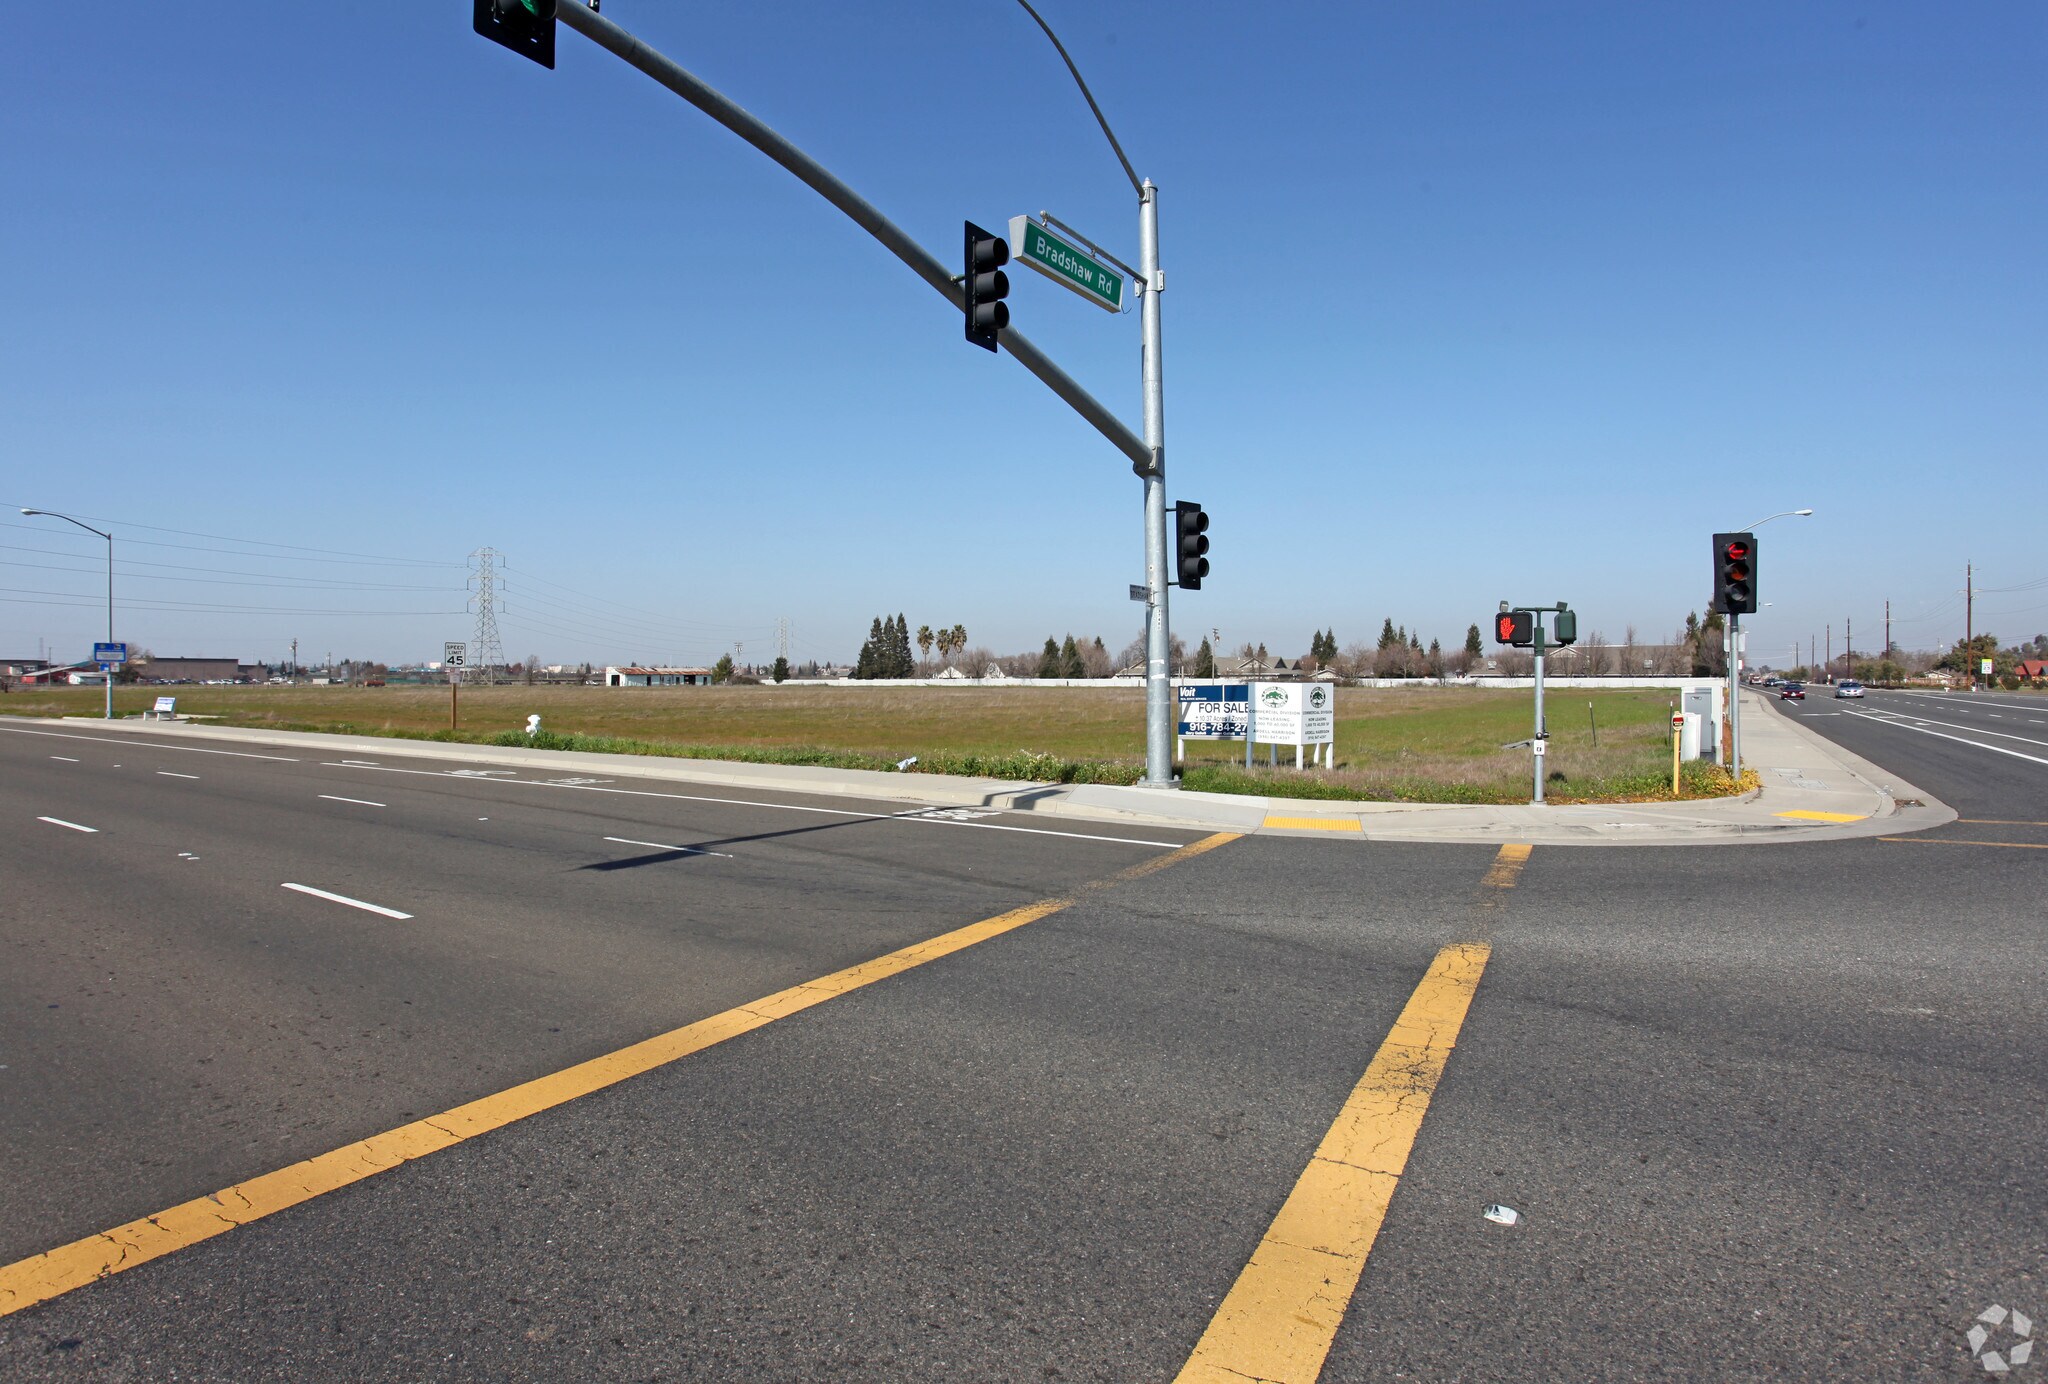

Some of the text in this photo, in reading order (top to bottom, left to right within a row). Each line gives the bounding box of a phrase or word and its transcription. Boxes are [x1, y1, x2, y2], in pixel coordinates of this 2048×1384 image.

[1036, 236, 1112, 294] Bradshaw Rd
[447, 656, 464, 665] 45
[1180, 687, 1196, 696] Voit
[1199, 703, 1248, 713] FOR SALE
